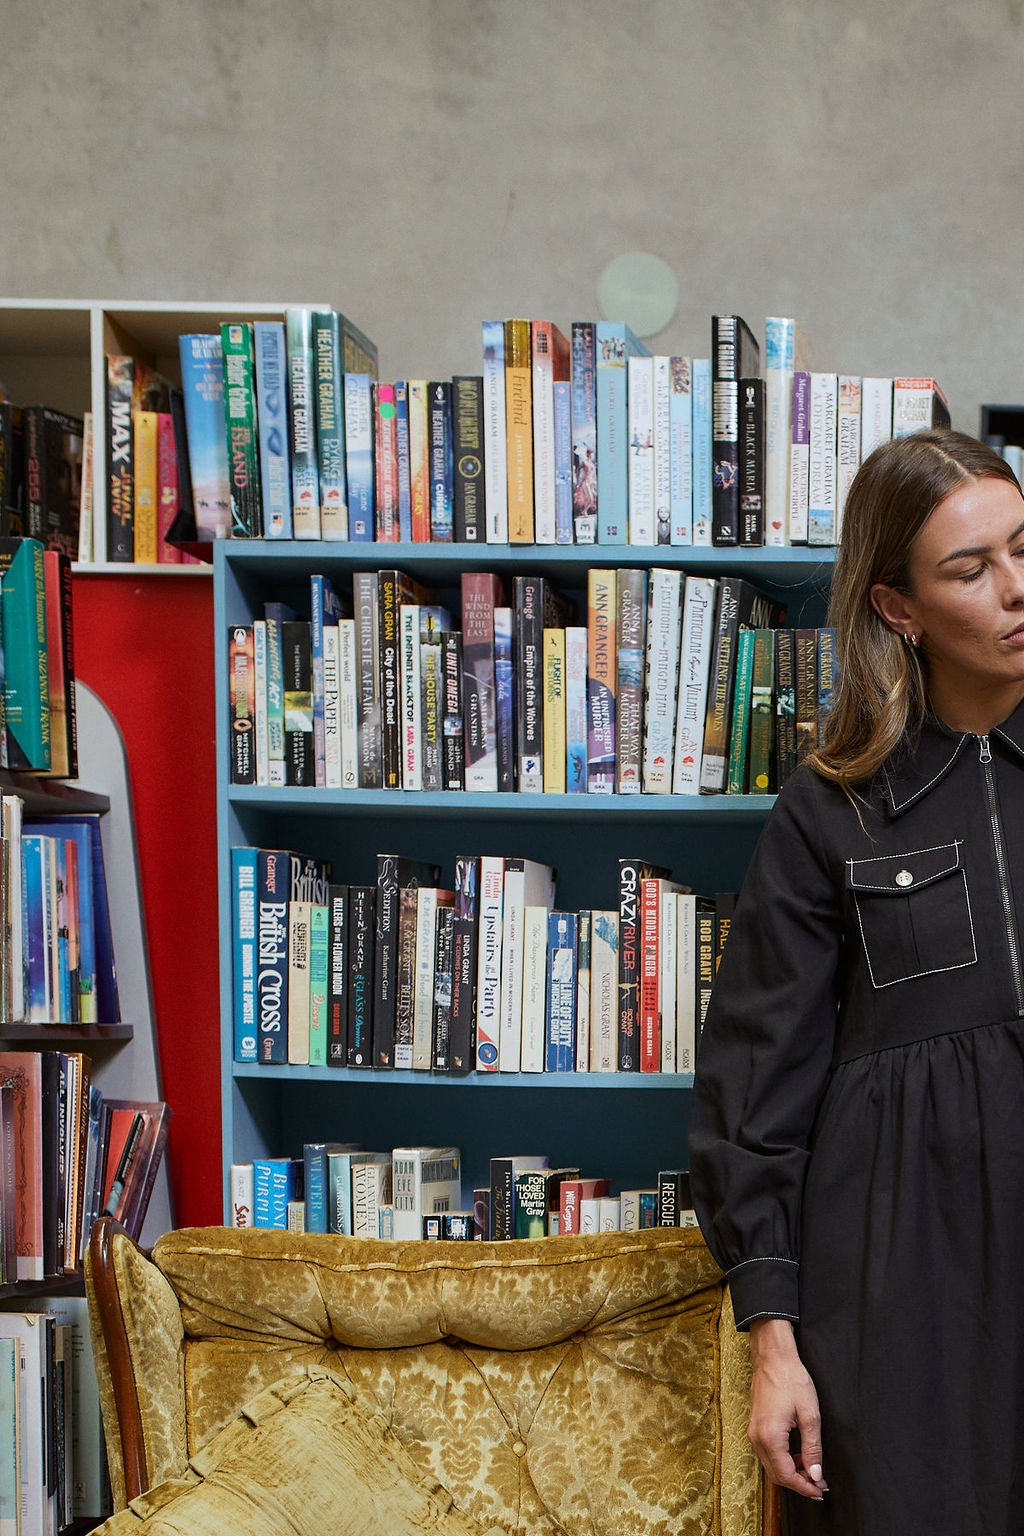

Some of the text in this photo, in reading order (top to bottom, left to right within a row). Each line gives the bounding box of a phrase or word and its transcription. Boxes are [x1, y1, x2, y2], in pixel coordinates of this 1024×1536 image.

[317, 329, 334, 429] HEATHER GRAHAM
[512, 375, 527, 425] Firebird
[291, 357, 308, 453] HEATHER GRAHAM
[347, 378, 359, 439] GRAHAM
[359, 386, 369, 432] HEATHER
[458, 381, 478, 448] MONUMENT
[796, 378, 807, 441] Margaret Graham
[112, 401, 131, 464] MAX
[823, 393, 833, 505] MARGARET GRAHAM
[840, 417, 849, 466] GRAHAM
[849, 418, 857, 466] MARGARET
[230, 426, 248, 488] ISLAND
[329, 439, 340, 478] DYING
[464, 482, 477, 523] IAN GRAHAM
[384, 582, 394, 640] SARA GRAN
[464, 612, 491, 620] FROM
[468, 620, 487, 628] THE
[523, 586, 535, 620] Grangé
[621, 590, 632, 643] GRANGER
[631, 604, 640, 629] ANN
[719, 586, 731, 629] GRANGER
[728, 599, 737, 619] ANN
[360, 577, 373, 715] THE CHRISTIE AFFAIR
[594, 584, 608, 679] ANN GRANGER
[38, 650, 49, 703] SUZANNE
[446, 651, 458, 713] UNIT OMEGA
[778, 633, 791, 686] ANN GRANGER
[806, 639, 815, 718] ANN GRANGER
[820, 633, 834, 690] ANN GRANGER
[269, 681, 280, 709] ACT
[325, 658, 338, 735] THE PAPER
[384, 648, 396, 725] City of the Dead
[426, 673, 435, 708] HOUSE
[524, 645, 536, 741] Empire of the Wolves
[713, 637, 731, 731] RATTLING THE BONES
[40, 705, 51, 744] FRANK
[426, 711, 436, 743] PARTY
[470, 694, 478, 746] GRANDES
[481, 688, 489, 749] ALMUDENA
[591, 695, 603, 741] MURDER
[599, 685, 612, 752] AN UNFINISHED
[619, 692, 629, 765] MURDER LIES
[629, 702, 640, 758] THAT WAY
[369, 752, 376, 761] de
[447, 738, 455, 770] GRAND
[265, 855, 277, 894] Granger
[645, 882, 656, 906] GOD'S
[259, 901, 287, 965] British
[332, 898, 343, 926] KILLERS
[444, 912, 453, 950] Wish You
[484, 906, 499, 962] Upstairs
[620, 866, 637, 970] CRAZY RIVER
[645, 909, 656, 941] MIDDLE
[700, 920, 712, 941] ROB
[239, 866, 254, 1024] BILL GRANGER BURNING THE APOSTLE
[332, 943, 343, 972] FLOWER
[381, 945, 389, 979] Katharine
[437, 928, 446, 970] Were Here
[461, 934, 471, 985] LINDA GRANT
[700, 945, 712, 982] GRANT
[332, 972, 343, 995] MOON
[454, 971, 461, 981] ON
[480, 977, 499, 1018] Party
[258, 968, 282, 1033] Cross
[452, 999, 460, 1017] BACKS
[550, 983, 560, 1045] MICHAEL GRANT
[559, 984, 572, 1047] LINE OF DUTY
[601, 972, 610, 1039] NICHOLAS GRANT
[620, 1010, 628, 1034] GRANT
[256, 1165, 271, 1223] PURPLE
[310, 1155, 322, 1209] WINTER
[355, 1168, 367, 1231] WOMEN
[394, 1195, 416, 1211] CITY
[397, 1178, 412, 1192] EVE
[515, 1184, 541, 1193] THOSE
[519, 1192, 545, 1200] LOVED
[520, 1199, 545, 1209] Martin
[528, 1176, 545, 1185] FOR
[661, 1183, 675, 1226] RESCUE
[526, 1207, 545, 1217] Gray
